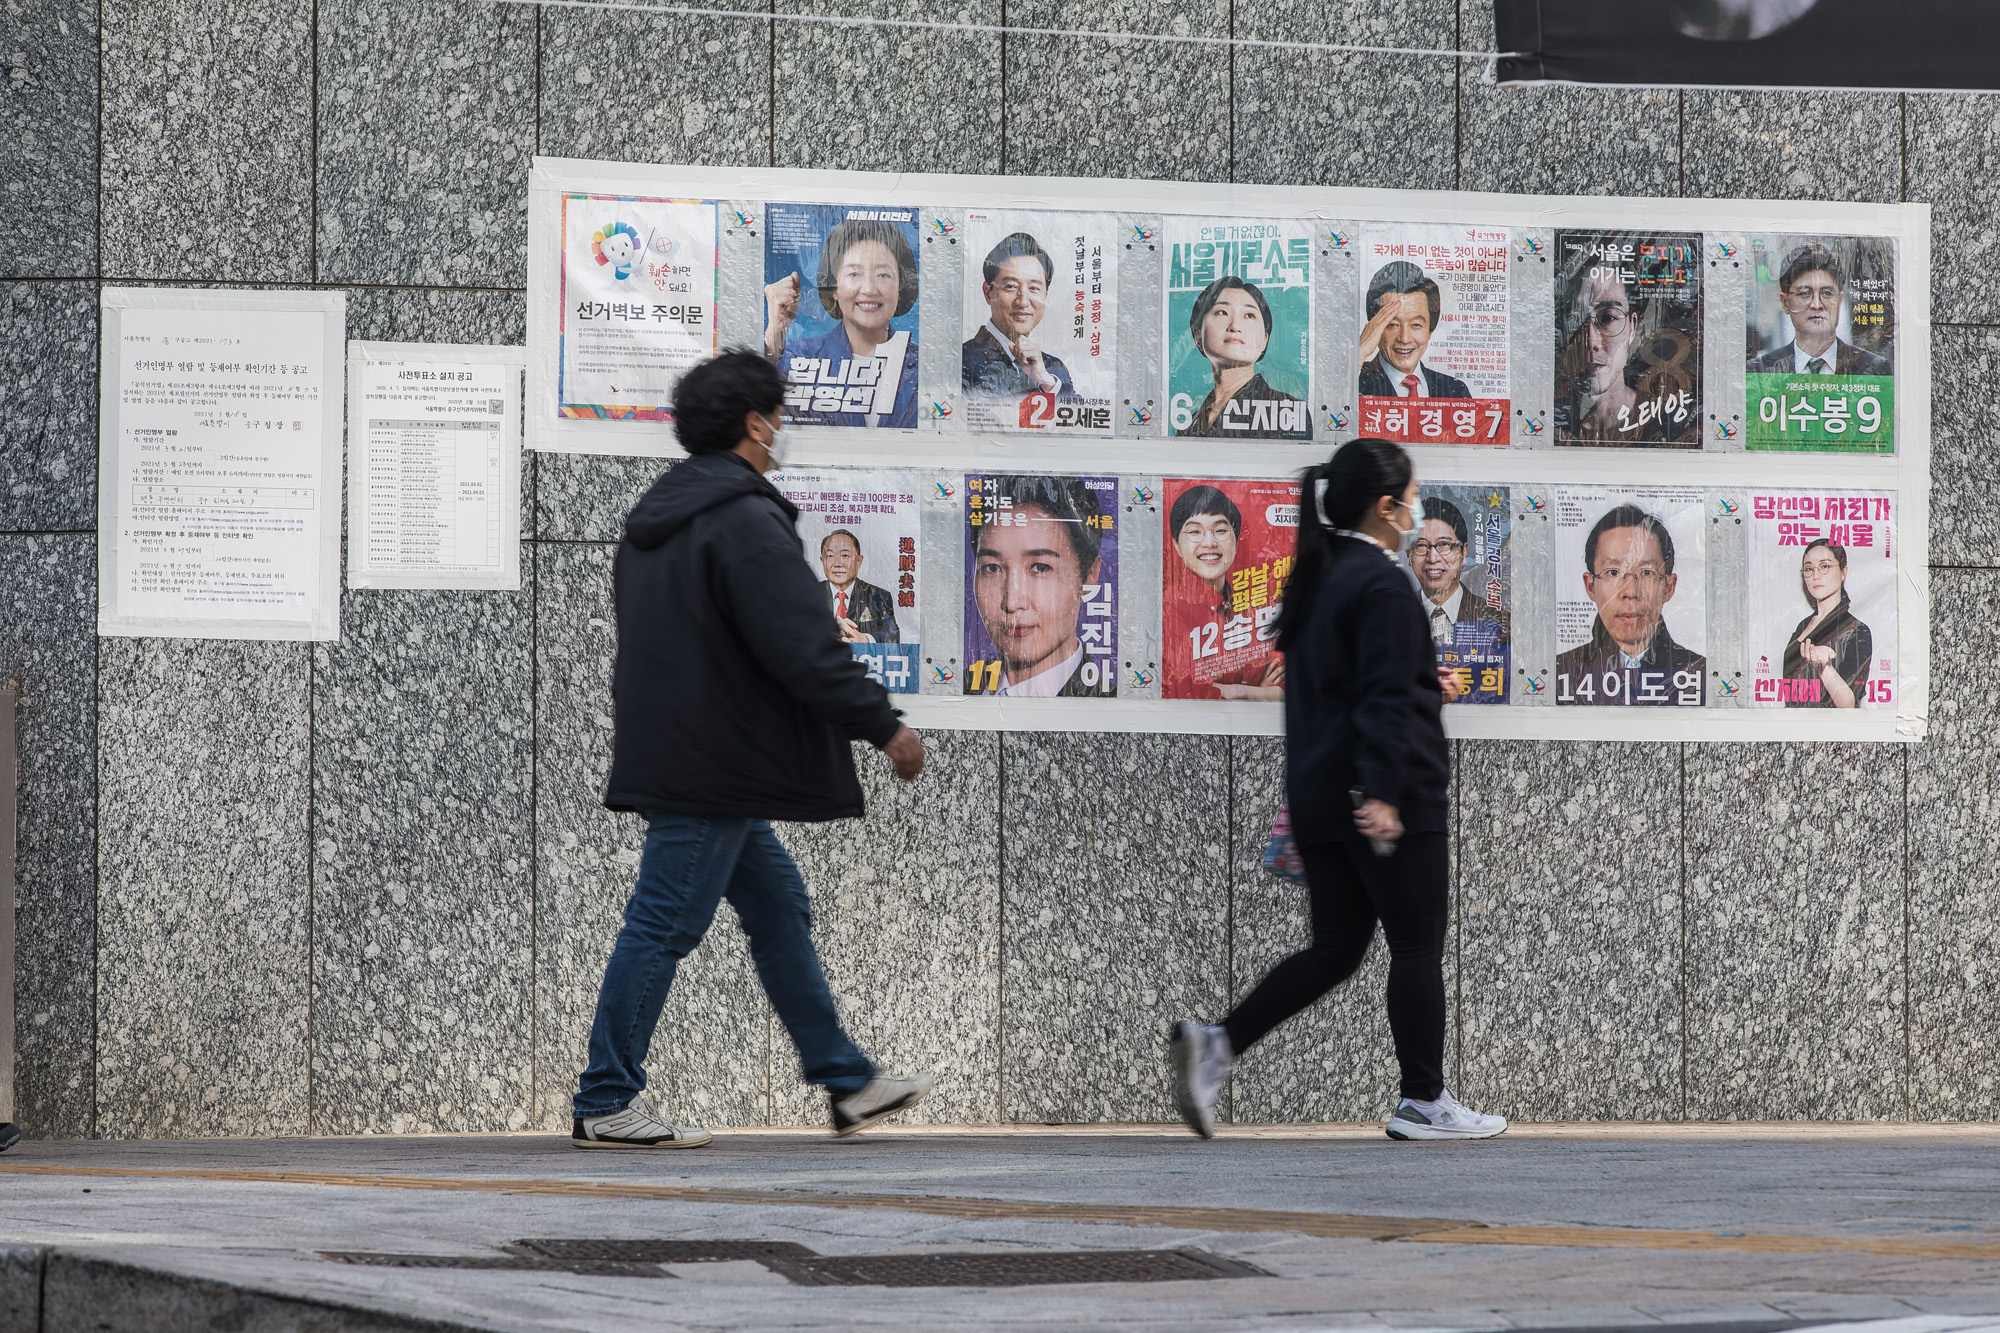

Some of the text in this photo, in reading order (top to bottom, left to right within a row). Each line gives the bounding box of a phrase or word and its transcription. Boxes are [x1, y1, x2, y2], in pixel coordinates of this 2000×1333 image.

[846, 210, 879, 221] 서울시
[1373, 244, 1507, 259] 국가에 돈이 없는 것이 아니라
[1589, 243, 1691, 263] 서울은 무지개
[648, 262, 691, 278] 훼손하면
[1091, 245, 1102, 295] 서울부터
[1424, 259, 1507, 273] 도둑놈이 많습니다
[1438, 272, 1506, 283] 국가 미래를 내다보는
[1589, 266, 1692, 286] 이기는 소수자
[654, 279, 667, 292] 안
[1073, 235, 1086, 339] 첫날부터 능숙하게
[1452, 283, 1480, 292] 허경영이
[1456, 293, 1506, 302] 그 나물에 그 밥
[1458, 303, 1473, 312] 이제
[1853, 304, 1884, 314] 서민 행복
[576, 301, 704, 324] 선거벽보 주의문
[1441, 314, 1460, 322] 서울시
[1462, 314, 1475, 323] 예산
[1477, 315, 1490, 323] 70%
[1853, 315, 1884, 326] 서울 혁명
[134, 360, 308, 375] 선거인명부 열람 및 등재여부 확인기간 등 공고
[397, 370, 473, 381] 사전투표소 설치 공고
[787, 356, 882, 386] 합니다
[874, 331, 913, 415] 1
[1785, 383, 1811, 391] 기본소득
[1812, 383, 1819, 391] 첫
[1841, 384, 1866, 392] 제3정치
[782, 385, 876, 414] 박영선
[1030, 395, 1050, 426] 2
[1617, 389, 1694, 432] 오태양
[1056, 407, 1111, 429] 오세훈
[1170, 392, 1193, 431] 6
[1222, 398, 1307, 432] 신지혜
[1759, 394, 1852, 434] 이수봉
[1856, 395, 1882, 434] 9
[1485, 410, 1504, 439] 7
[968, 478, 999, 493] 여자
[1084, 481, 1114, 491] 여성의당
[1288, 487, 1302, 495] 진보
[820, 492, 850, 502] 에덴동산
[851, 493, 866, 502] 공원
[868, 493, 897, 503] 100만평
[848, 504, 878, 513] 복지정책
[968, 494, 1014, 509] 혼자도
[1753, 496, 1891, 521] 당신의 자리가
[824, 515, 862, 525] 예산효율화
[1085, 514, 1114, 530] 서울
[1274, 514, 1301, 523] 지지후
[1486, 512, 1501, 544] 서울
[1778, 522, 1820, 546] 있는
[1828, 523, 1873, 547] 서울
[1232, 562, 1269, 592] 강남
[1273, 555, 1297, 580] 해
[1486, 546, 1502, 579] 경제
[1232, 582, 1268, 613] 평등
[1080, 582, 1114, 693] 김진아
[1222, 602, 1284, 651] 송명
[1189, 621, 1219, 661] 12
[852, 654, 911, 688] 영규
[968, 659, 1003, 691] 11
[1438, 667, 1504, 696] 동희
[1557, 672, 1596, 702] 14
[1602, 669, 1702, 706] 이도엽
[1754, 678, 1821, 703] 신지예
[1867, 679, 1892, 703] 15
